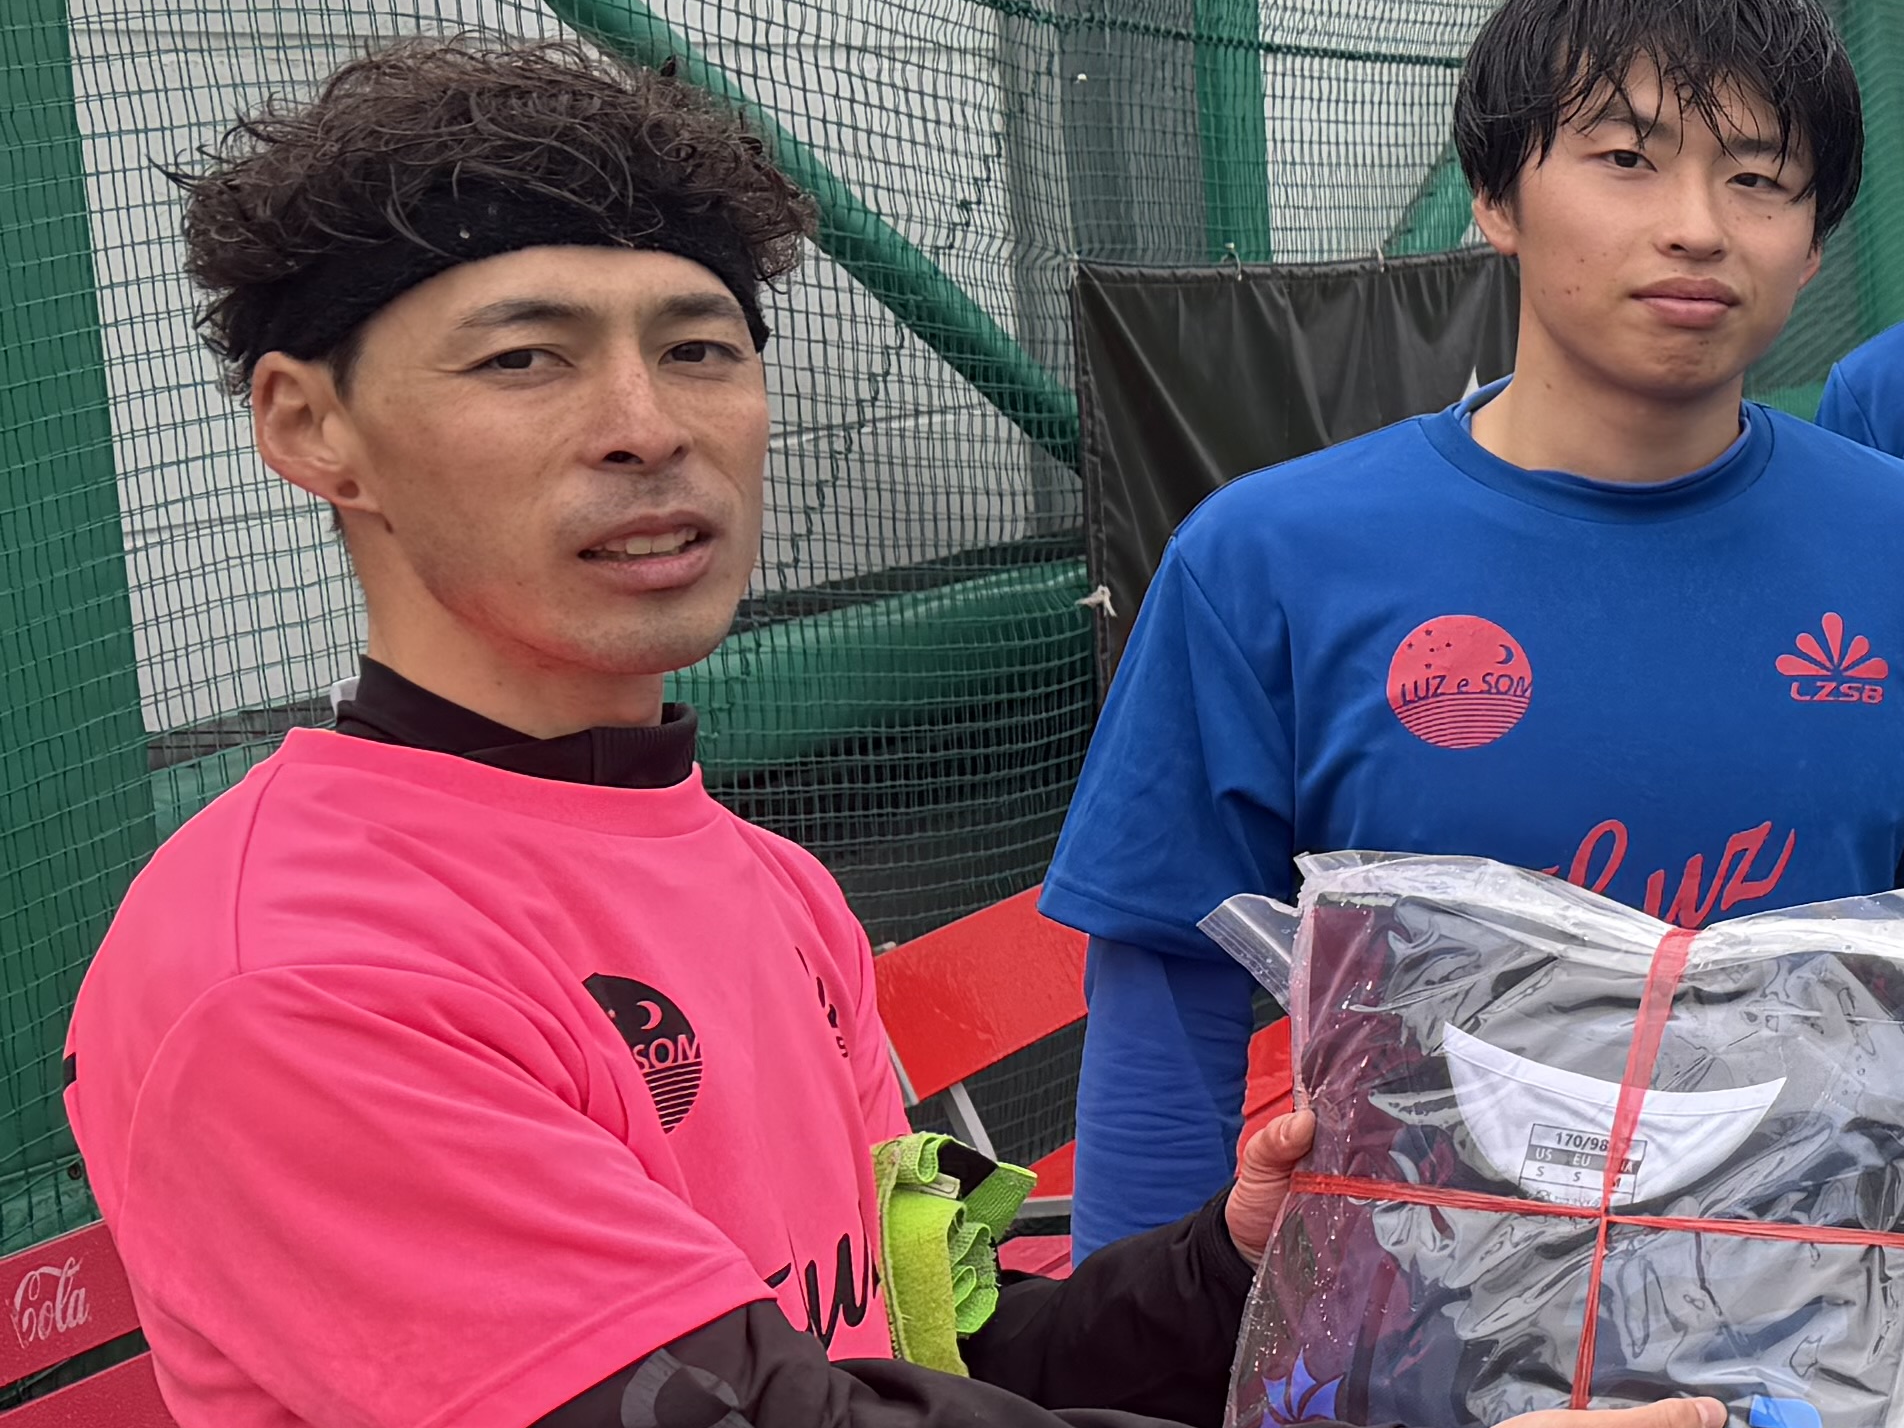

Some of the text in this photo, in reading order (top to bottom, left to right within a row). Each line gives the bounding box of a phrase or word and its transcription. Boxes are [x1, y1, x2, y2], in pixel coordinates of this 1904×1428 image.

[1401, 675, 1447, 706] LUZ
[1457, 678, 1470, 695] e
[1790, 681, 1885, 704] LZSB
[1535, 1147, 1592, 1167] US EU
[1535, 1165, 1583, 1182] S S
